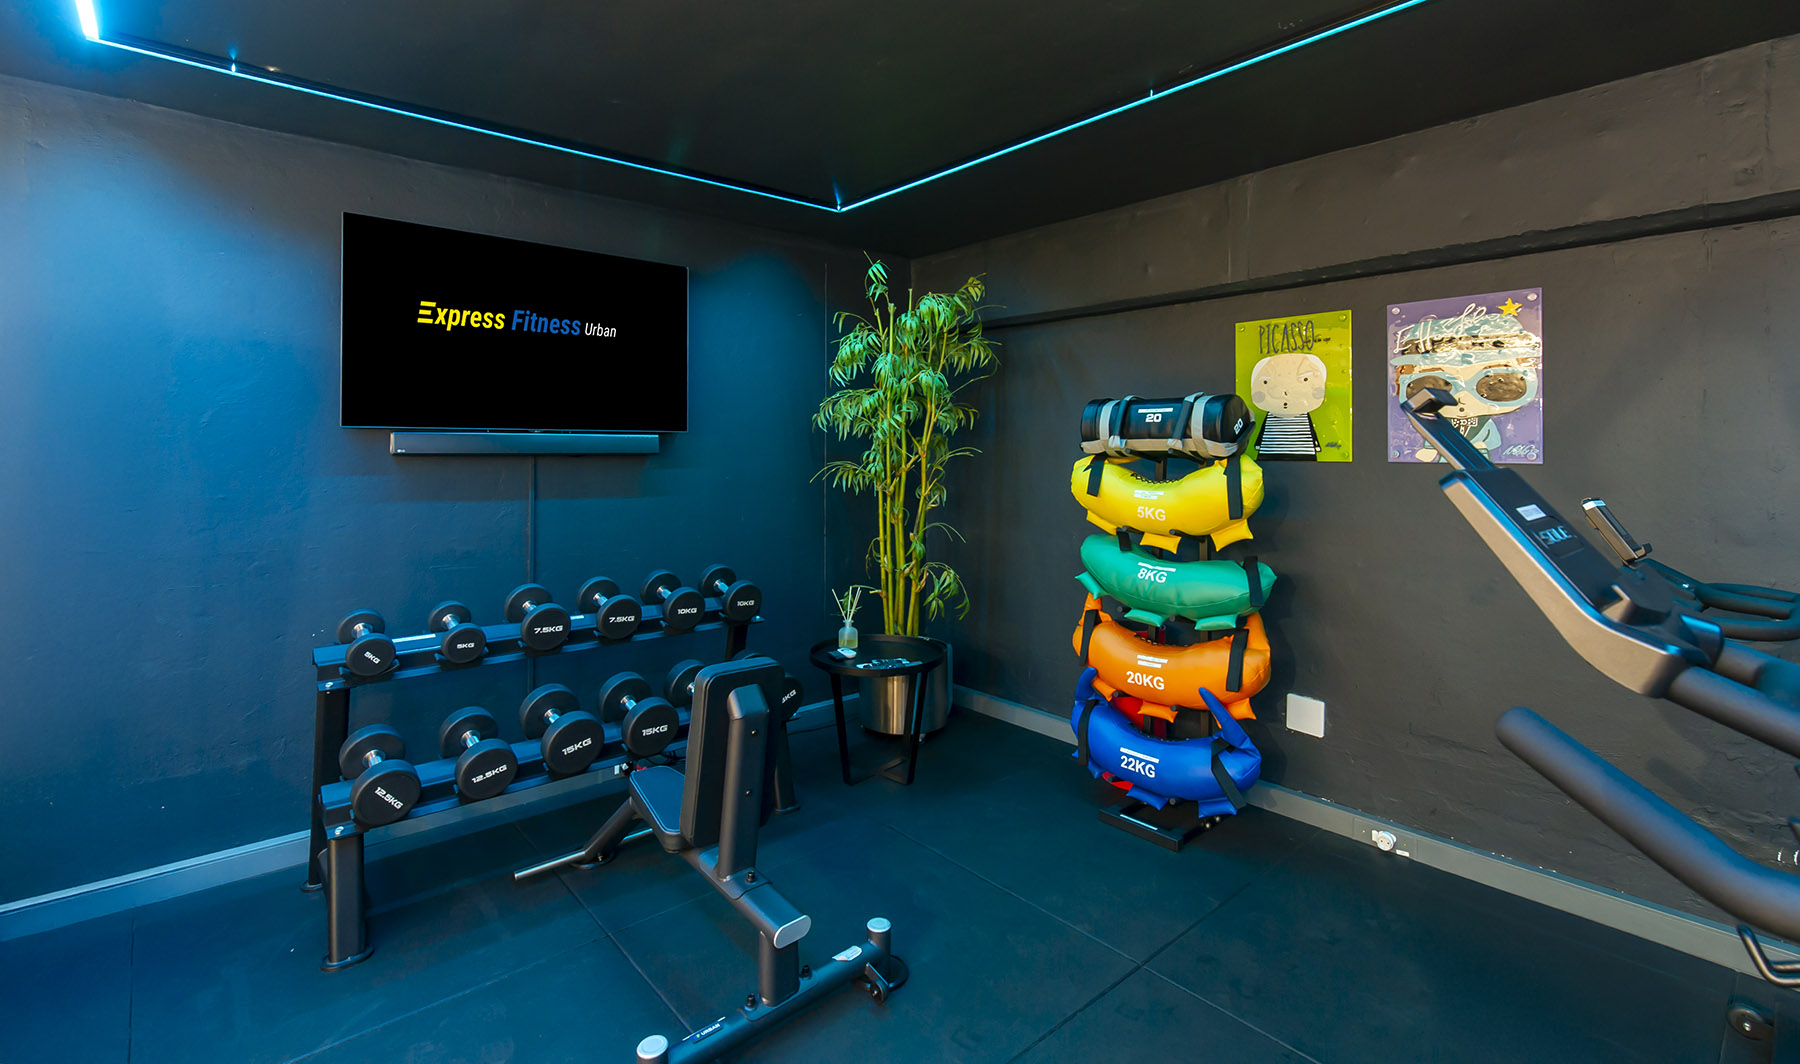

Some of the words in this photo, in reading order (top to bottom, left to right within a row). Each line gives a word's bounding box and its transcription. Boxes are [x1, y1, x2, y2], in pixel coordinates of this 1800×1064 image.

[416, 300, 506, 332] Express
[511, 309, 582, 336] Fitness
[584, 322, 618, 338] Urban
[1259, 320, 1315, 354] PICASSO
[1145, 413, 1162, 423] 20
[1233, 417, 1244, 435] 20
[1136, 505, 1166, 521] 5KG
[1137, 568, 1168, 584] 8KG
[677, 607, 698, 615] 10KG
[608, 615, 636, 624] 7.5KG
[533, 625, 564, 635] 7.5KG
[456, 642, 475, 650] 5KG
[363, 651, 381, 665] 5KG
[1126, 670, 1165, 691] 20KG
[641, 724, 669, 737] 15KG
[561, 737, 592, 756] 15KG
[471, 763, 508, 785] 12.5KG
[1120, 756, 1156, 779] 22KG
[374, 785, 404, 810] 12.5KG
[700, 1023, 721, 1036] URBAN
